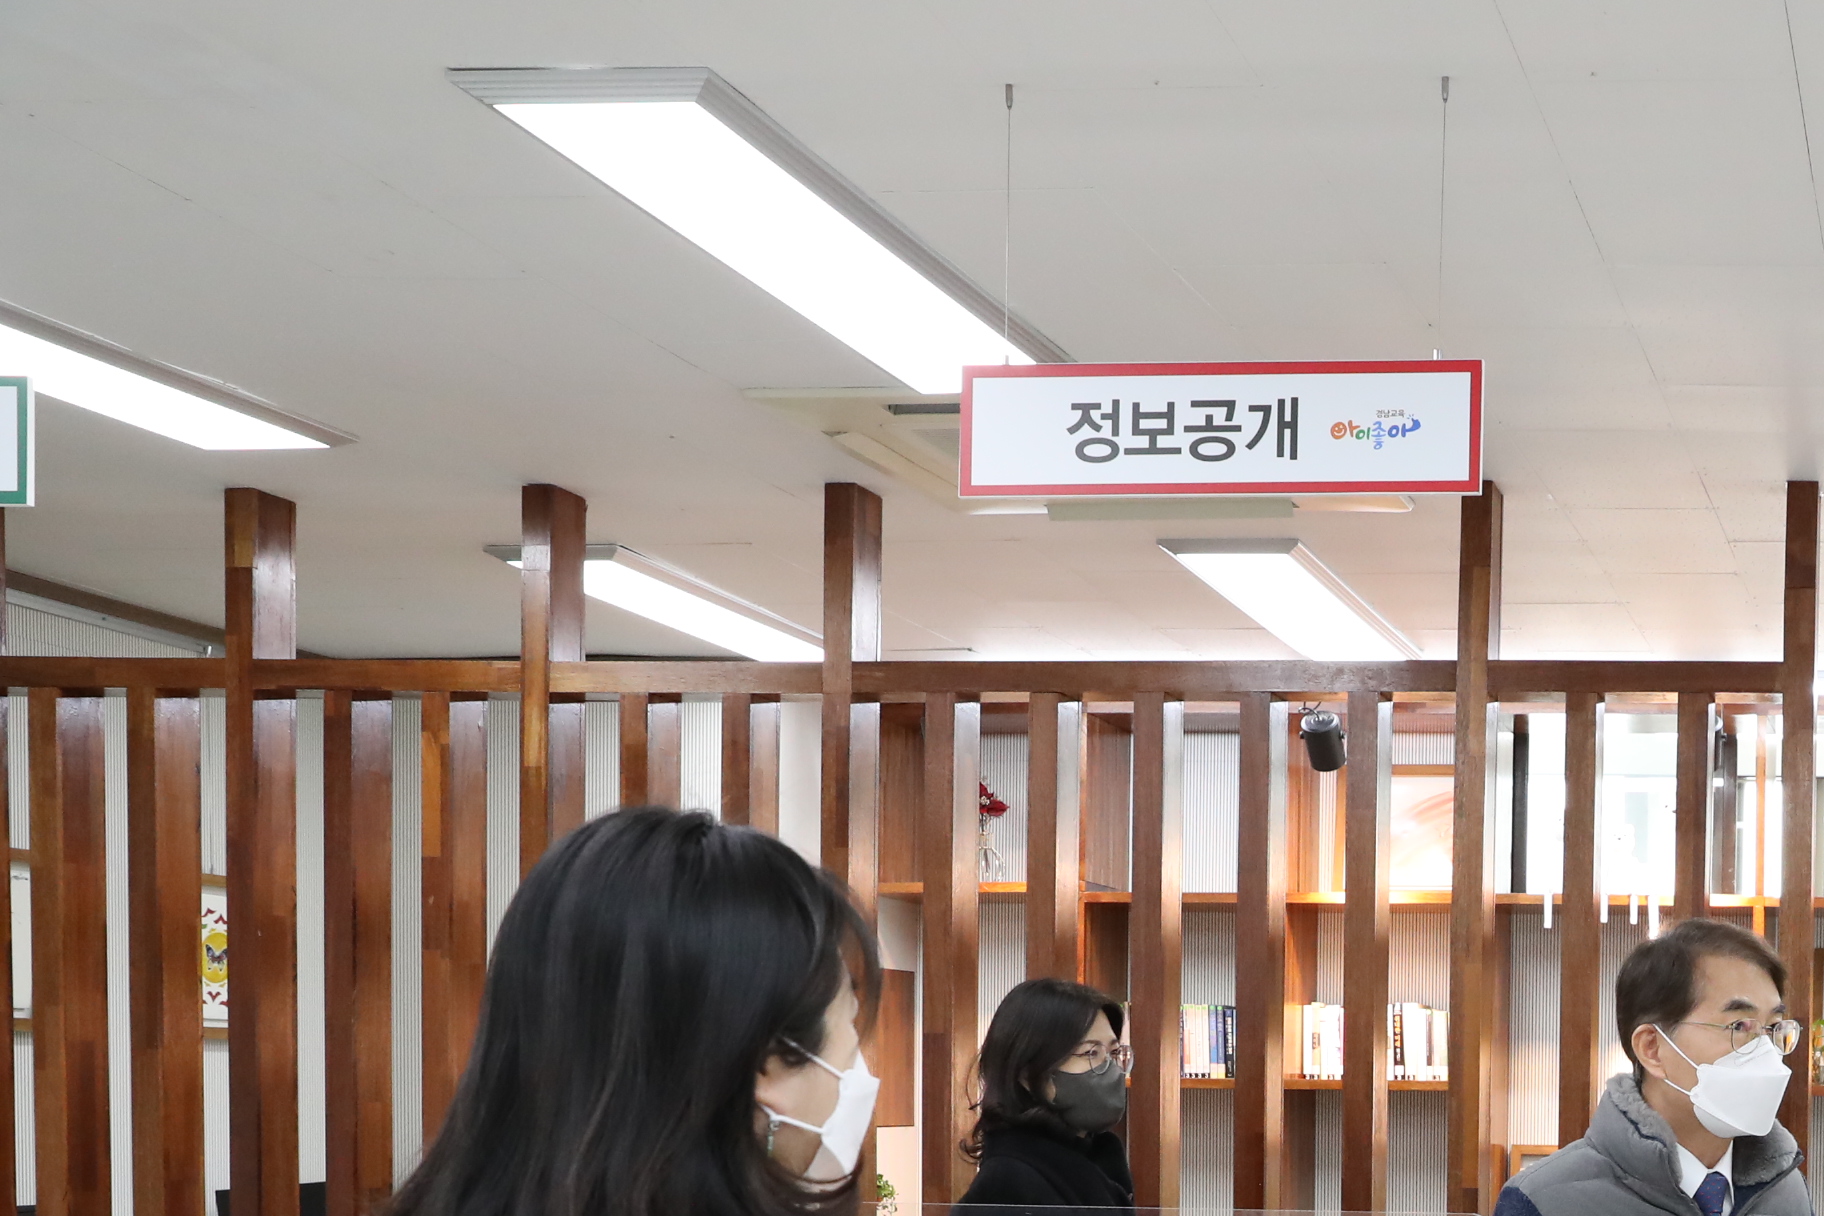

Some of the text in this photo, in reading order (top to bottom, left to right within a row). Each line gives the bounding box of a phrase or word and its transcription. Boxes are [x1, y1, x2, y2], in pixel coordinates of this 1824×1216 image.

[1066, 397, 1299, 464] 정보공개
[1330, 413, 1421, 450] 아이좋아
[1376, 409, 1406, 419] 경남교육
